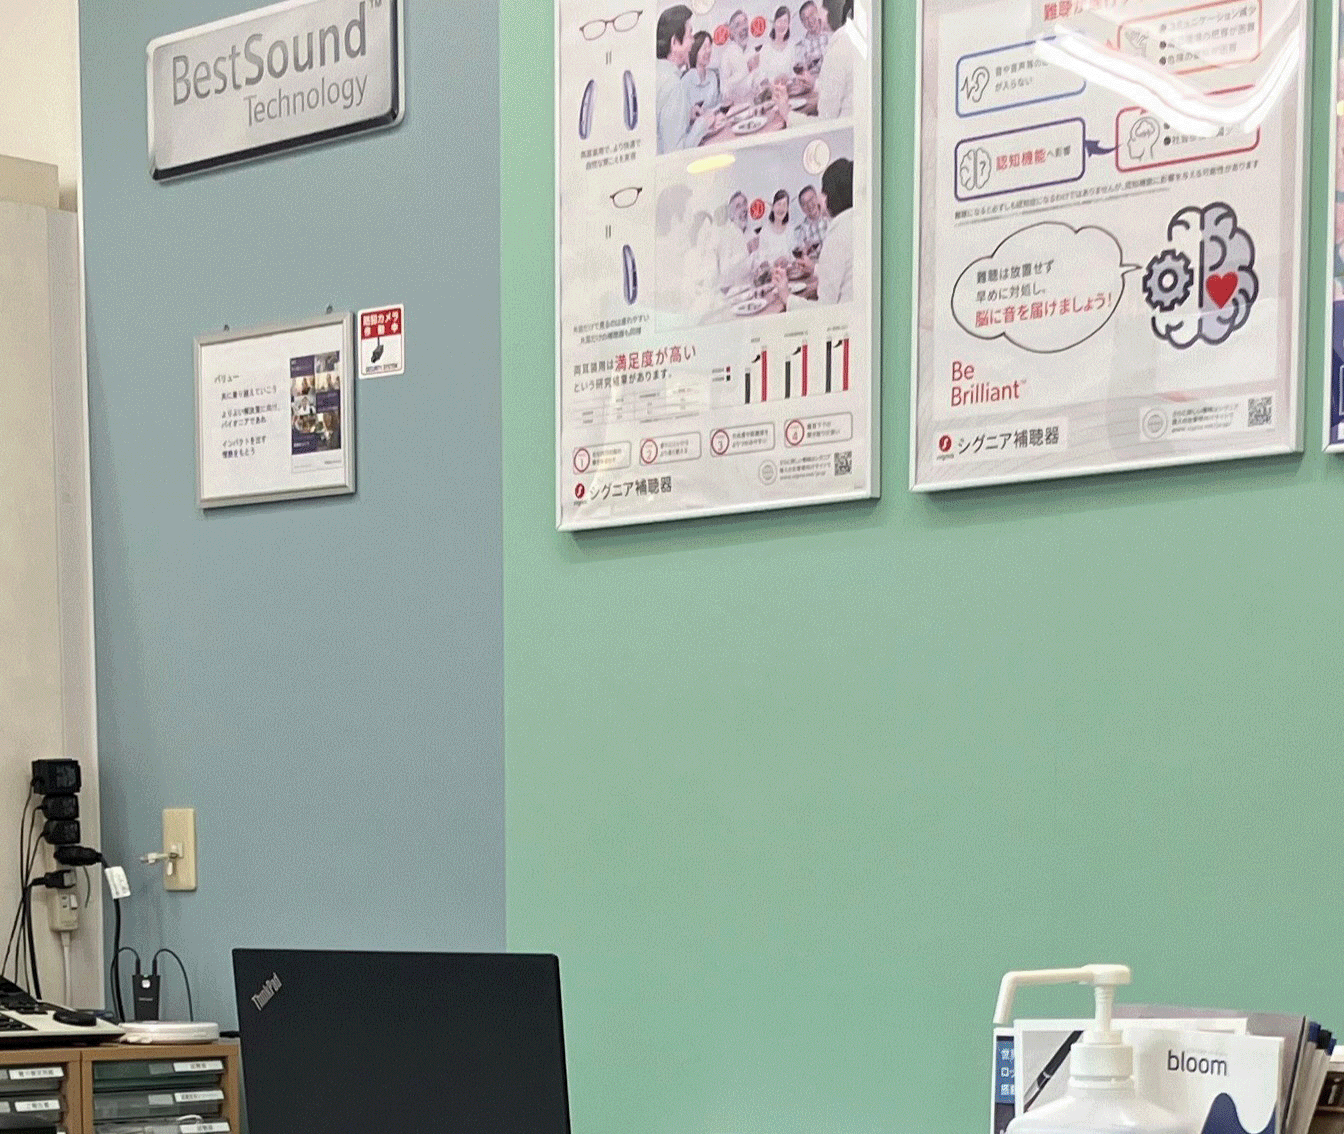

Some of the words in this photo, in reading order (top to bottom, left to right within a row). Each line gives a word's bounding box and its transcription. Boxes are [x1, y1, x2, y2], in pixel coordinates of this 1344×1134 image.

[172, 1, 367, 106] BestSound
[244, 72, 368, 127] Technology
[995, 145, 1071, 171] 認知機能へ影響
[976, 259, 1054, 284] 難聴は放置せず
[976, 282, 1046, 303] 早めに対処し、
[975, 292, 1112, 328] 脳に音を届けましょう!
[951, 360, 975, 382] Be
[957, 425, 1060, 456] シグニア補聴器
[589, 476, 672, 501] シグニア補聴器
[251, 972, 282, 1011] ThinkPad
[1166, 1049, 1228, 1077] bloom
